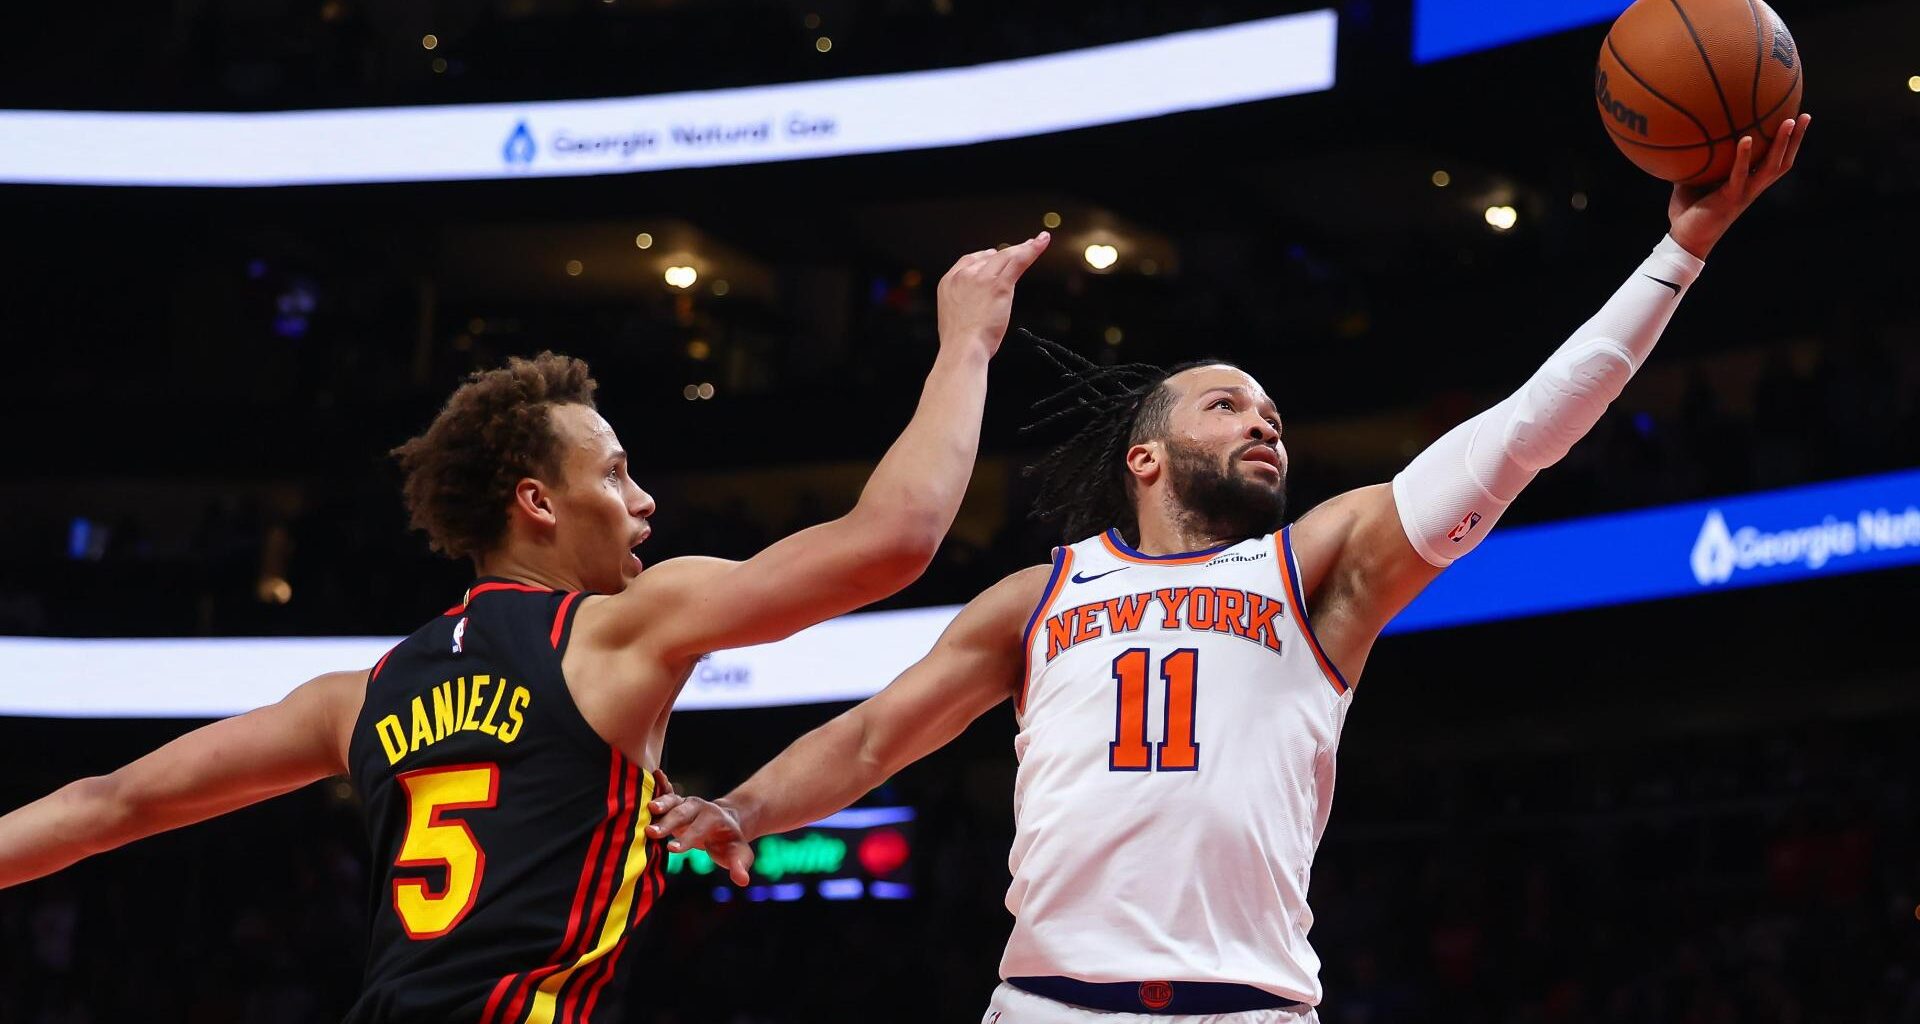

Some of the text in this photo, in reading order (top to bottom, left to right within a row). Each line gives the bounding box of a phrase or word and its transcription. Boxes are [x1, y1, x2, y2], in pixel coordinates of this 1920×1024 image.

[553, 113, 837, 156] Georgia Natural Gas
[1732, 515, 1857, 569] Georgia
[1045, 585, 1284, 666] NEW YORK
[375, 674, 531, 766] DANIELS
[1108, 647, 1200, 772] 11
[392, 761, 501, 941] 5
